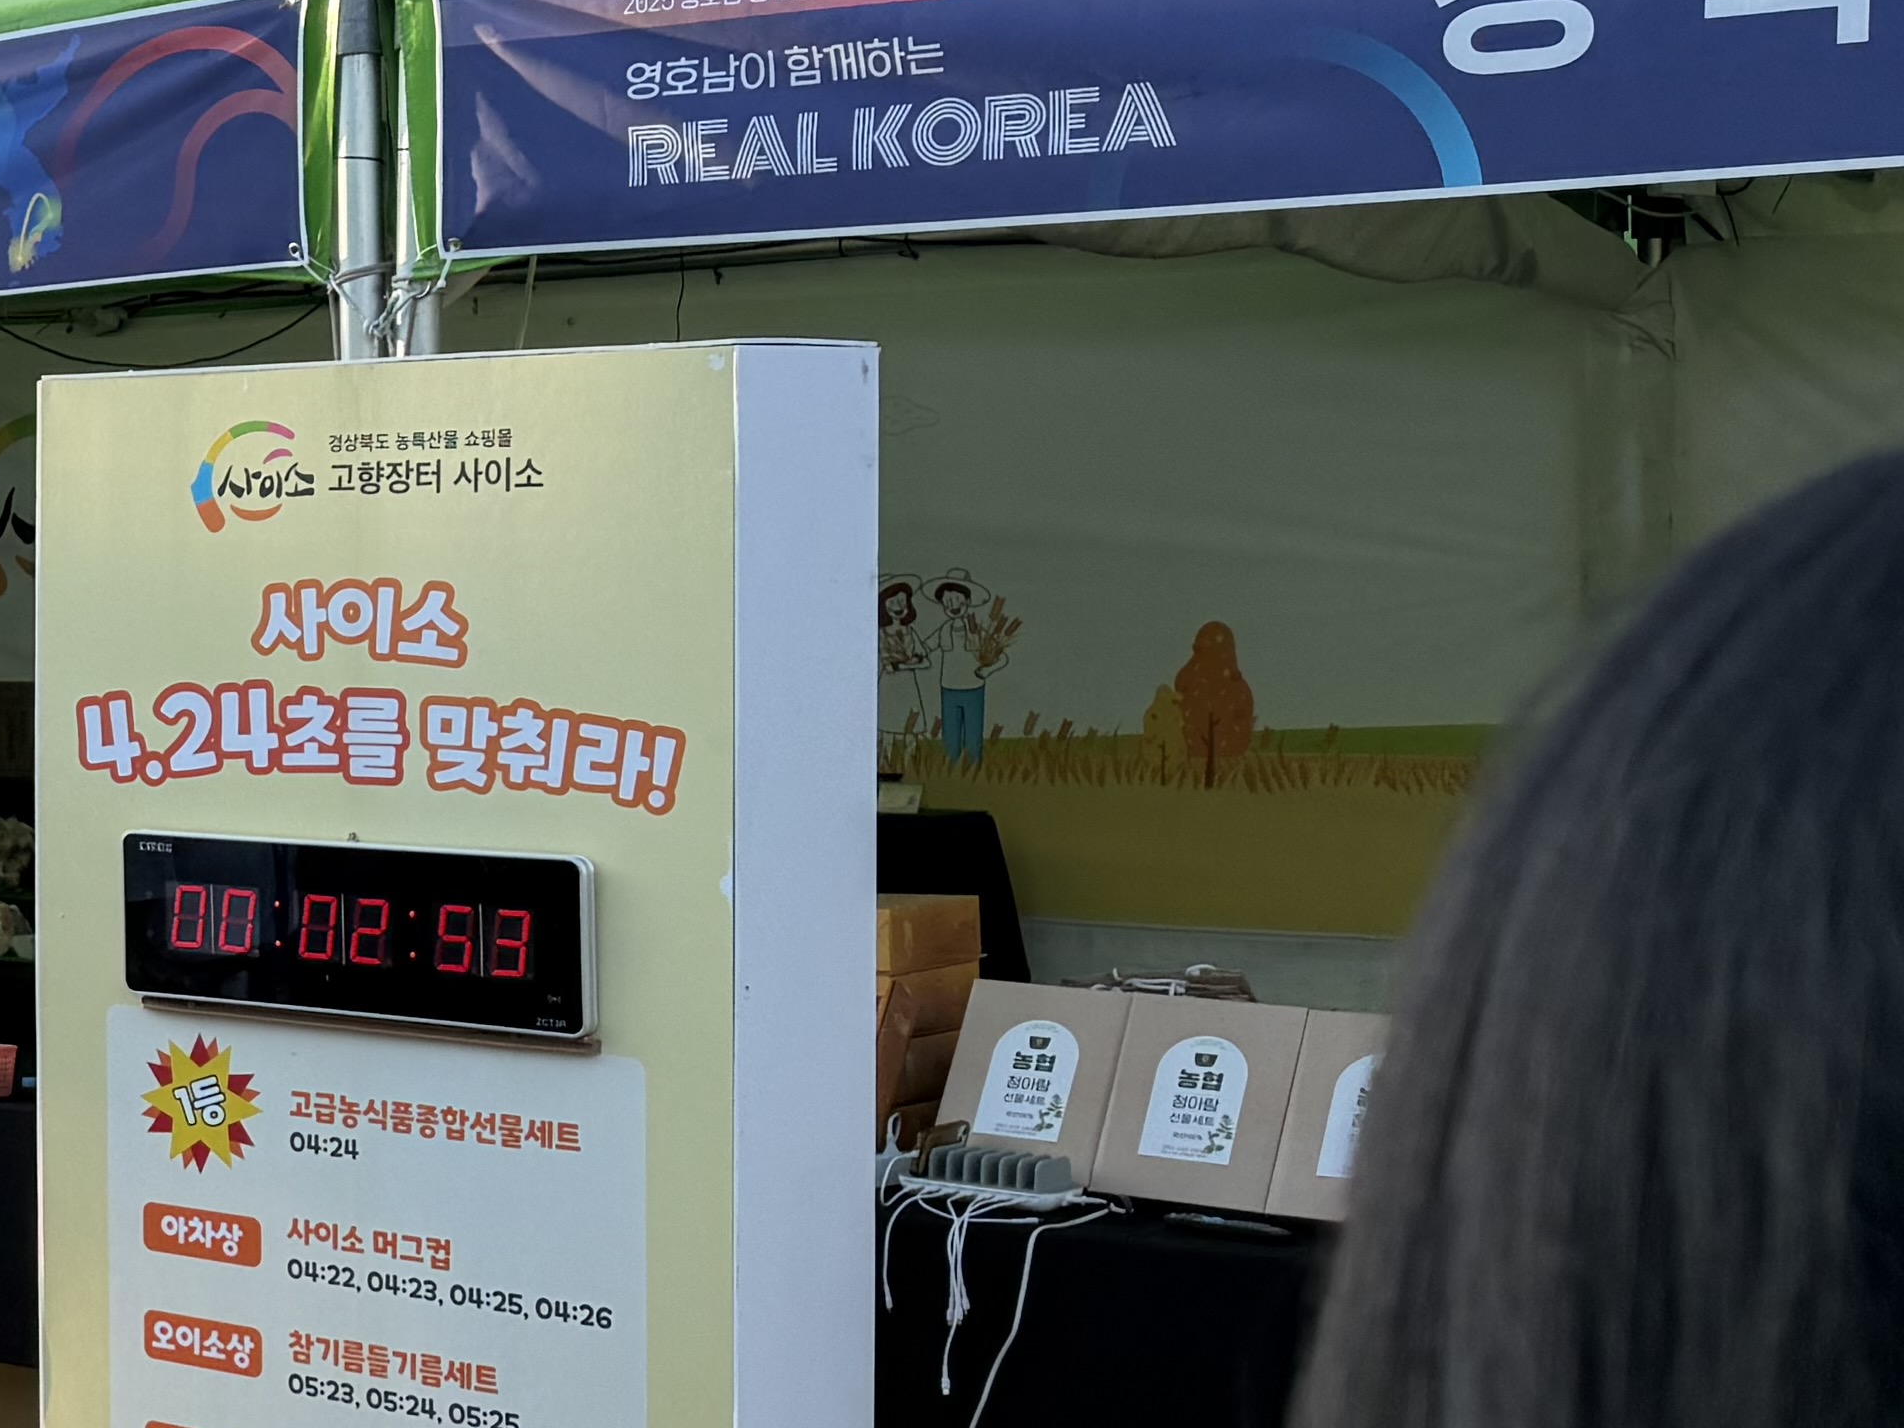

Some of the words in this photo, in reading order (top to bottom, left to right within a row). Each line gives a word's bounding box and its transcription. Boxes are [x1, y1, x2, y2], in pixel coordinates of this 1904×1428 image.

[625, 50, 777, 101] 영호남이
[786, 36, 945, 87] 함께하는
[628, 111, 839, 188] REAL
[852, 81, 1177, 172] KOREA
[328, 433, 390, 453] 경상북도
[395, 430, 459, 450] 농특산물
[464, 428, 513, 448] 쇼핑몰
[328, 458, 442, 496] 고향장터
[453, 457, 544, 493] 사이소
[253, 578, 468, 666] 사이소
[79, 682, 408, 784] 4.24초를
[422, 698, 683, 812] 맞춰라!
[1013, 1051, 1057, 1073] 농협
[1178, 1069, 1224, 1092] 농협
[172, 1074, 228, 1128] 1등
[289, 1090, 582, 1153] 고급농식품종합선물세트
[289, 1132, 359, 1160] 04:24
[160, 1214, 244, 1259] 아차상
[287, 1218, 366, 1255] 사이소
[372, 1229, 452, 1271] 머그컵
[287, 1258, 362, 1293] 04:22,
[367, 1270, 443, 1306] 04:23,
[450, 1284, 529, 1320] 04:25,
[535, 1298, 613, 1330] 04:26
[151, 1322, 255, 1370] 오이소상
[288, 1330, 499, 1396] 참기름들기름세트
[288, 1374, 360, 1409] 05:23,
[366, 1387, 443, 1425] 05:24,
